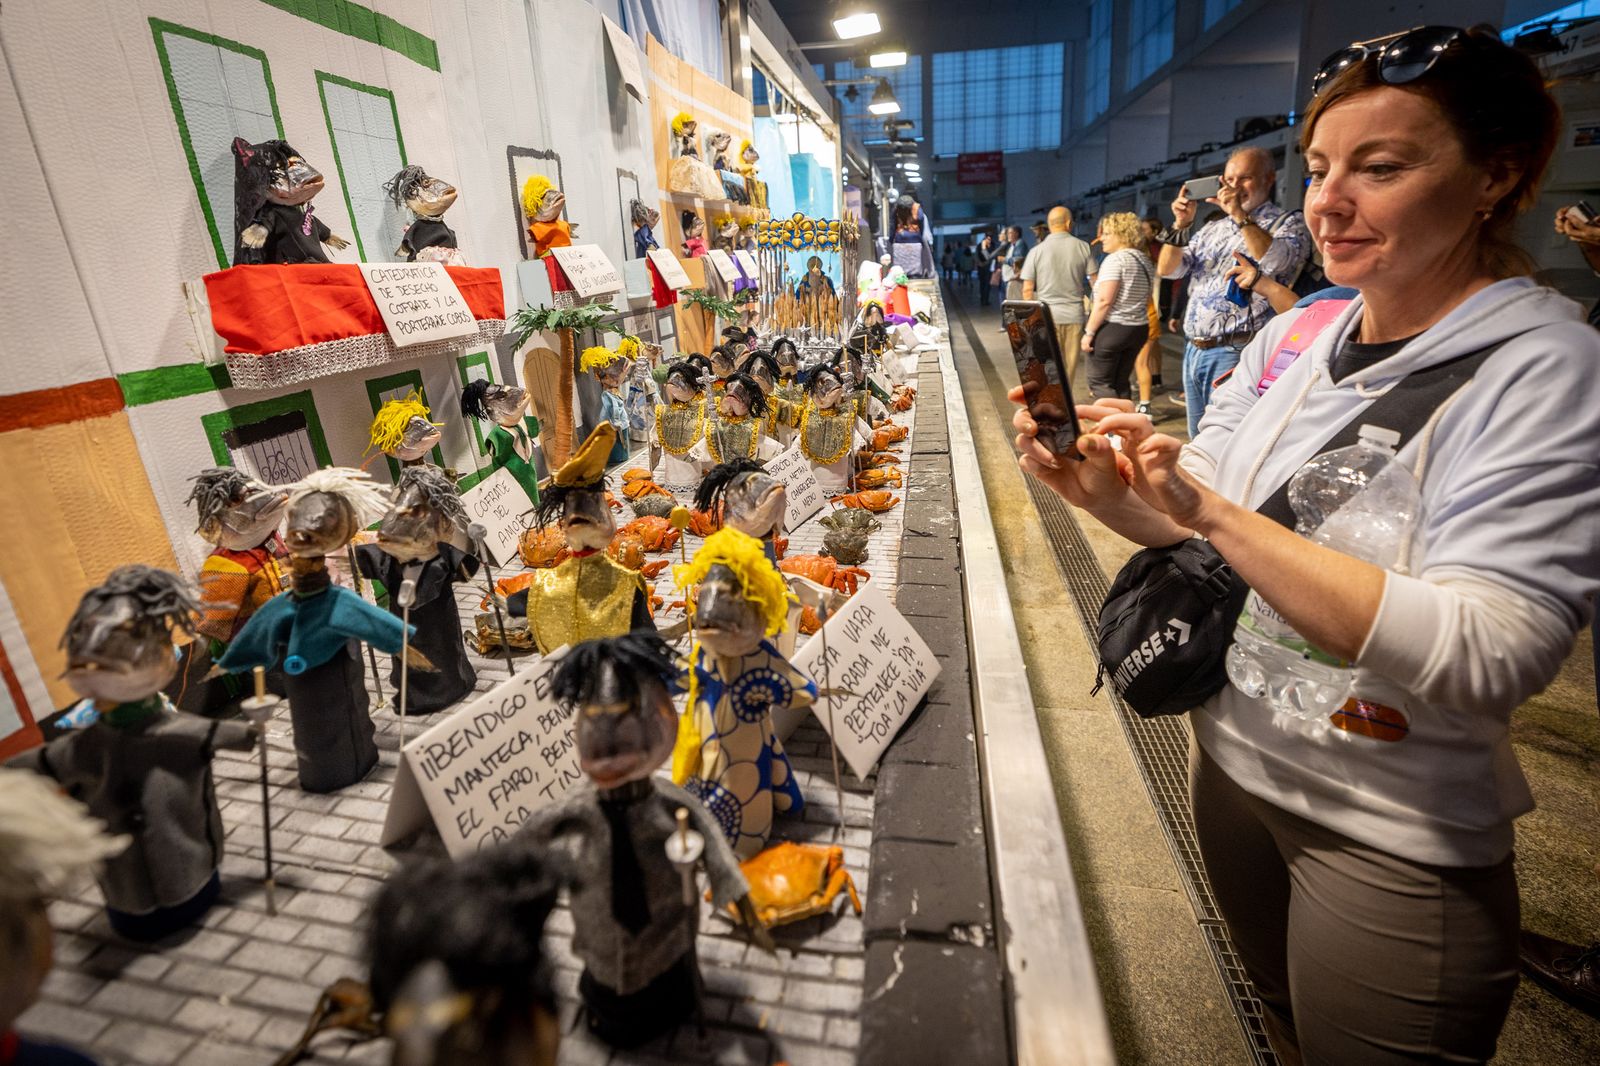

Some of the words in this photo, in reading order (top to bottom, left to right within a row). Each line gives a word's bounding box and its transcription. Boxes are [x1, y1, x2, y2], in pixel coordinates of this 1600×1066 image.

[378, 287, 394, 299] DE
[395, 282, 438, 297] DESECHO
[433, 296, 442, 308] Y
[444, 295, 459, 308] LA
[473, 480, 511, 518] COFRADE
[493, 504, 510, 520] DEL
[791, 506, 801, 521] EN
[497, 513, 529, 549] AMOR
[842, 604, 877, 644] VARA
[870, 626, 891, 654] ME
[1112, 631, 1165, 696] ONVERSE
[844, 660, 902, 735] PERTENECE
[893, 690, 908, 716] LA
[444, 730, 541, 805] MANTECA,
[456, 807, 484, 840] EL
[488, 766, 540, 811] FARO,
